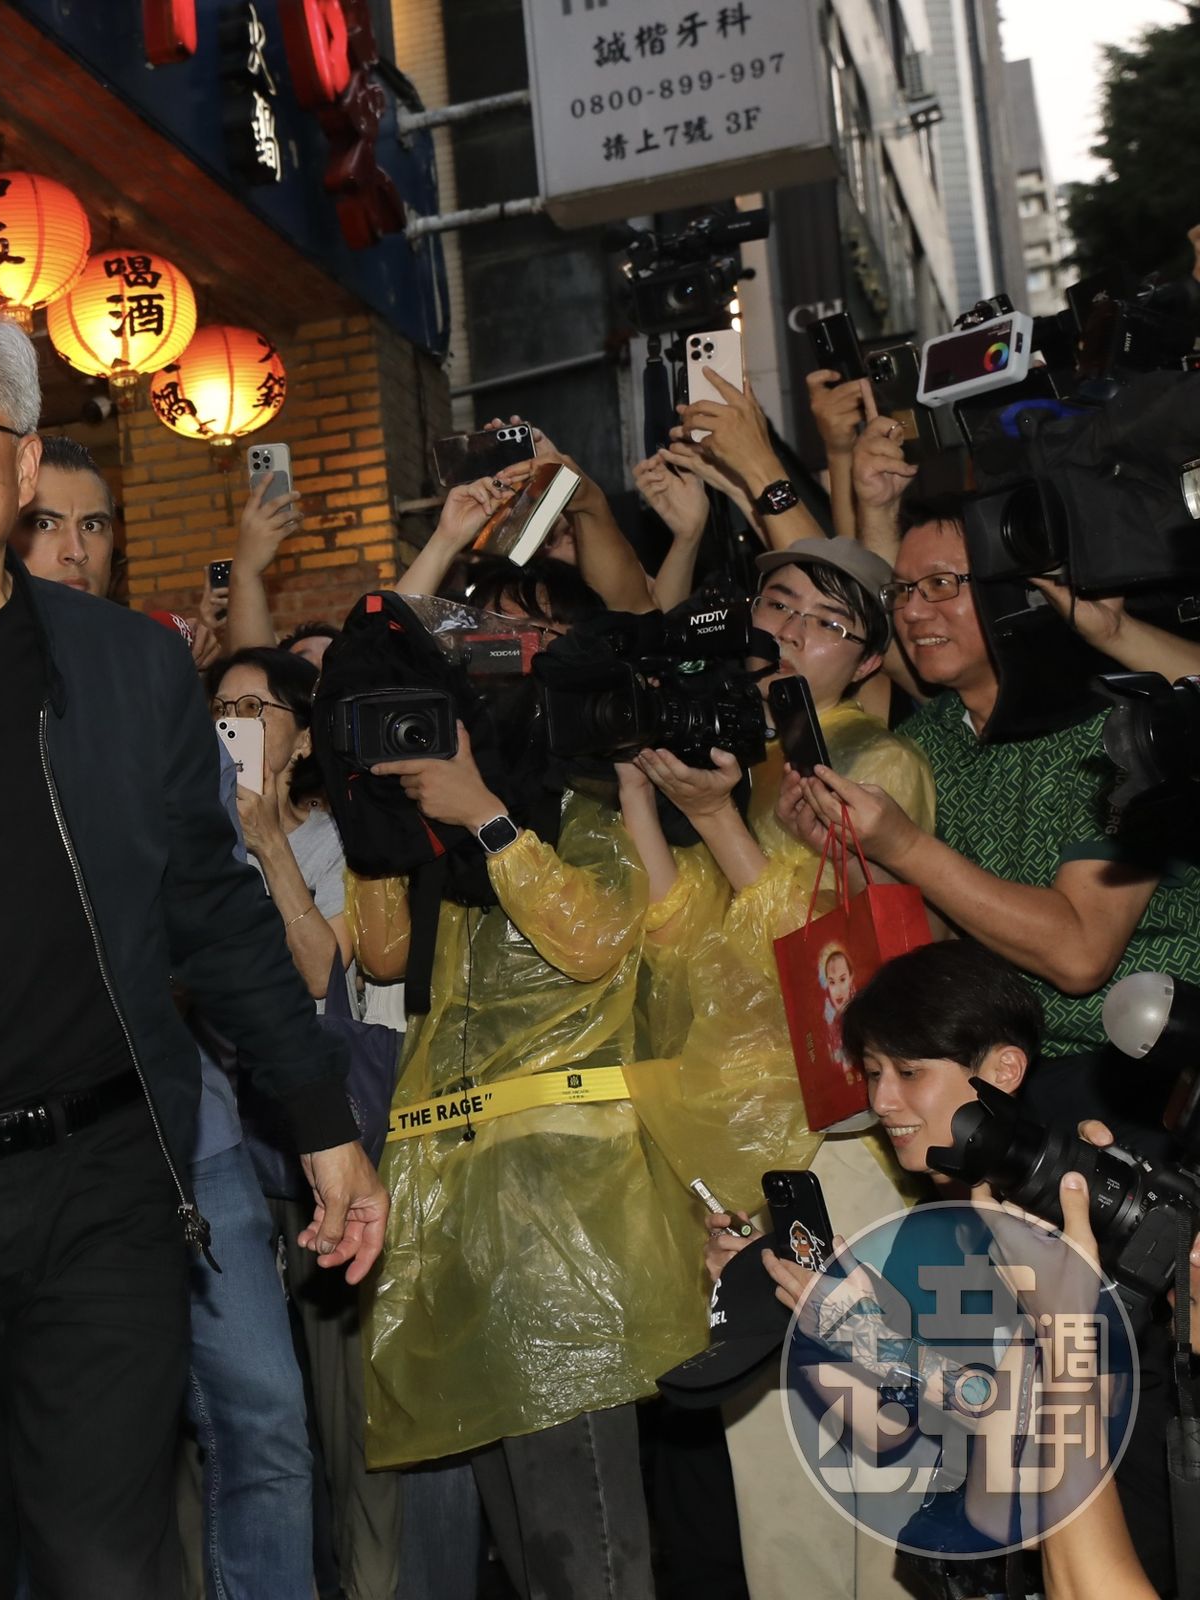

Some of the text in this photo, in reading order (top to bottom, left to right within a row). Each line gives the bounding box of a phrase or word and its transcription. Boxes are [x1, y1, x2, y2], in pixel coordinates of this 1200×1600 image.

[594, 2, 751, 67] 誠楷牙科
[571, 53, 785, 119] 0800-899-997
[603, 107, 761, 161] 請上7號 3F
[105, 255, 165, 338] 喝酒
[690, 609, 728, 626] NTDTV
[398, 1108, 431, 1129] THE
